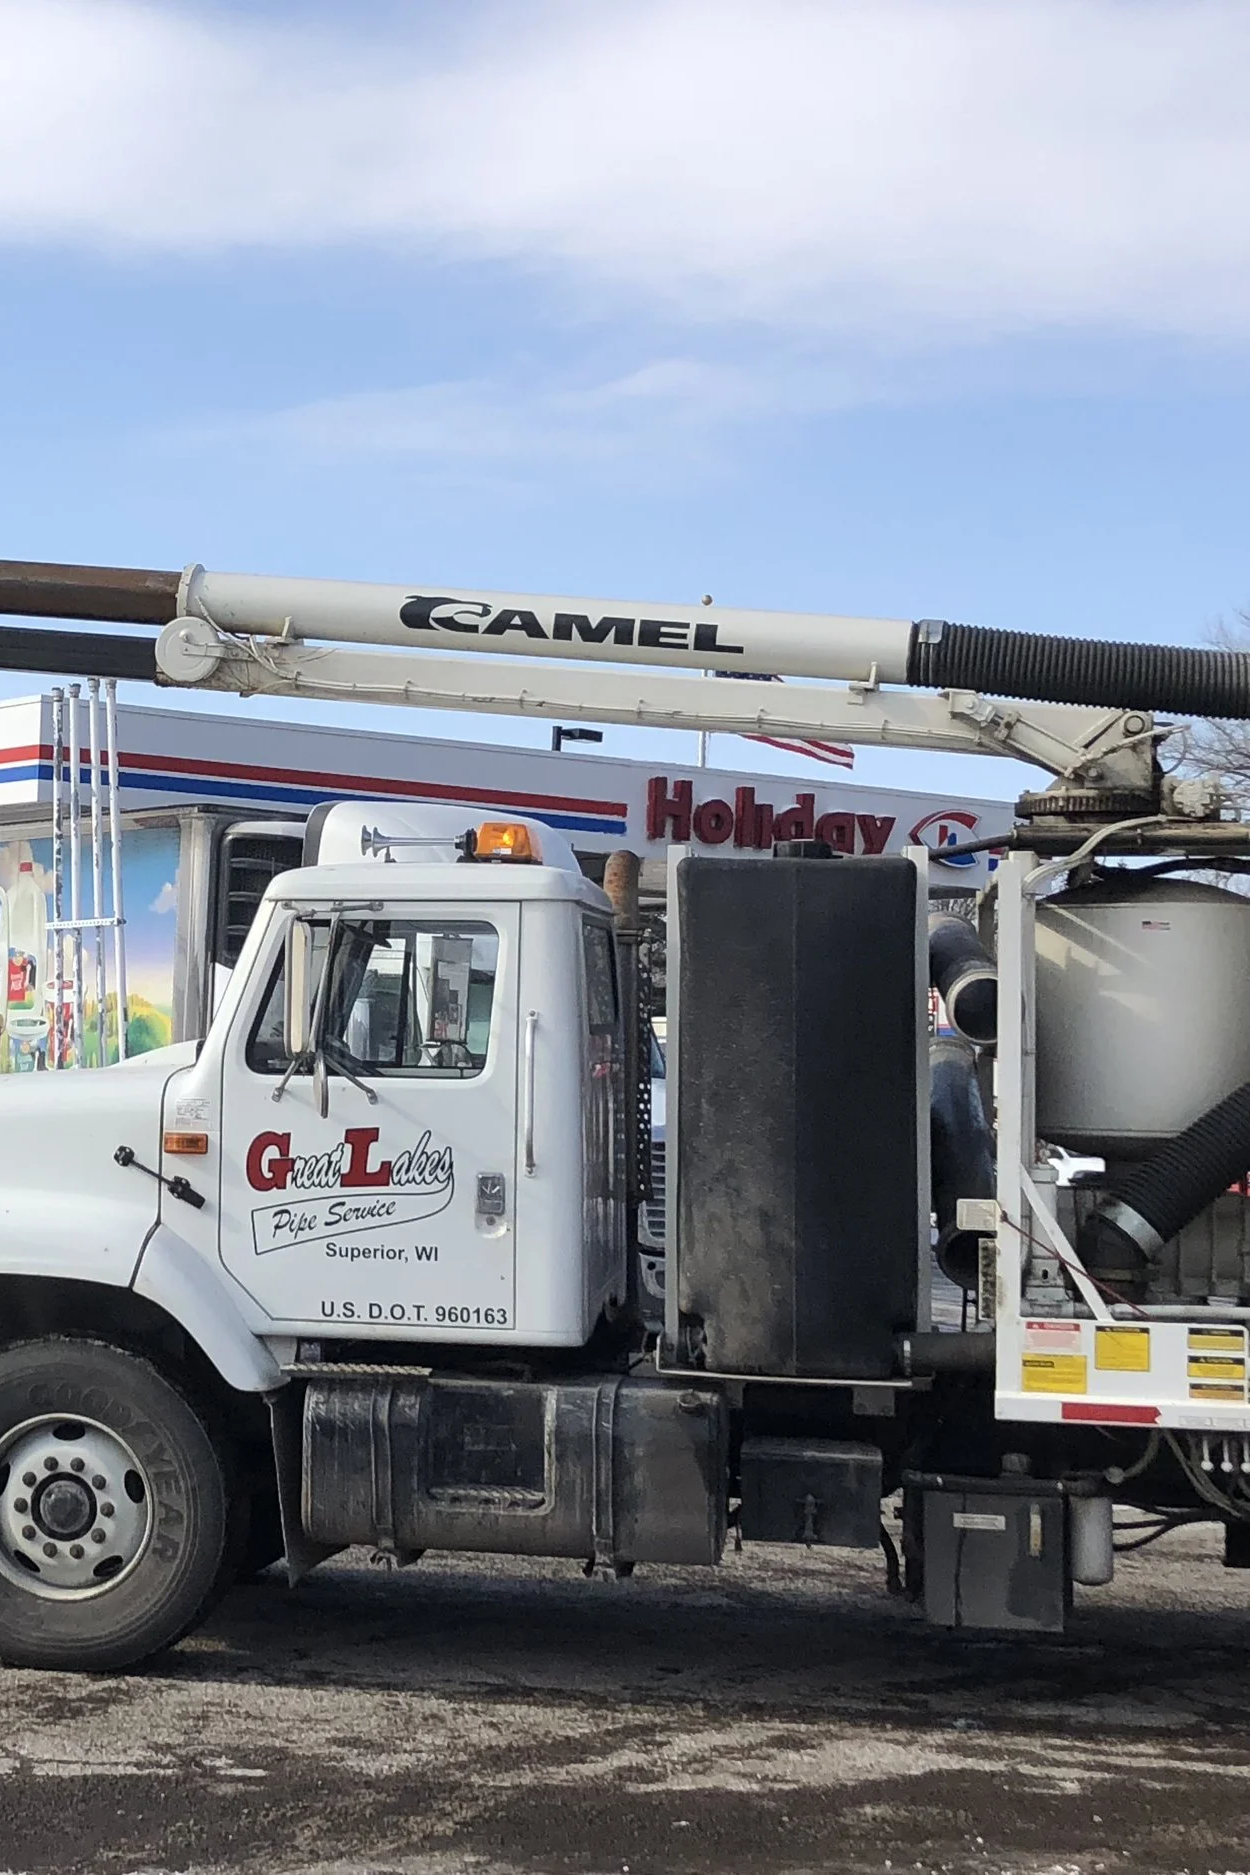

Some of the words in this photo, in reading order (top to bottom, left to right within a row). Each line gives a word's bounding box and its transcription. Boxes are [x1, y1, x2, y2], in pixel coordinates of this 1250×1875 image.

[399, 595, 744, 654] CAMEL
[646, 776, 897, 856] Holiday
[246, 1131, 345, 1192] Great
[339, 1127, 453, 1188] Lakes
[272, 1208, 317, 1240] Pipe
[324, 1200, 396, 1227] Service
[325, 1242, 409, 1263] Superior,
[415, 1246, 439, 1262] WI
[321, 1301, 361, 1318] U.S.
[368, 1303, 428, 1321] D.O.T.
[435, 1306, 507, 1324] 960163
